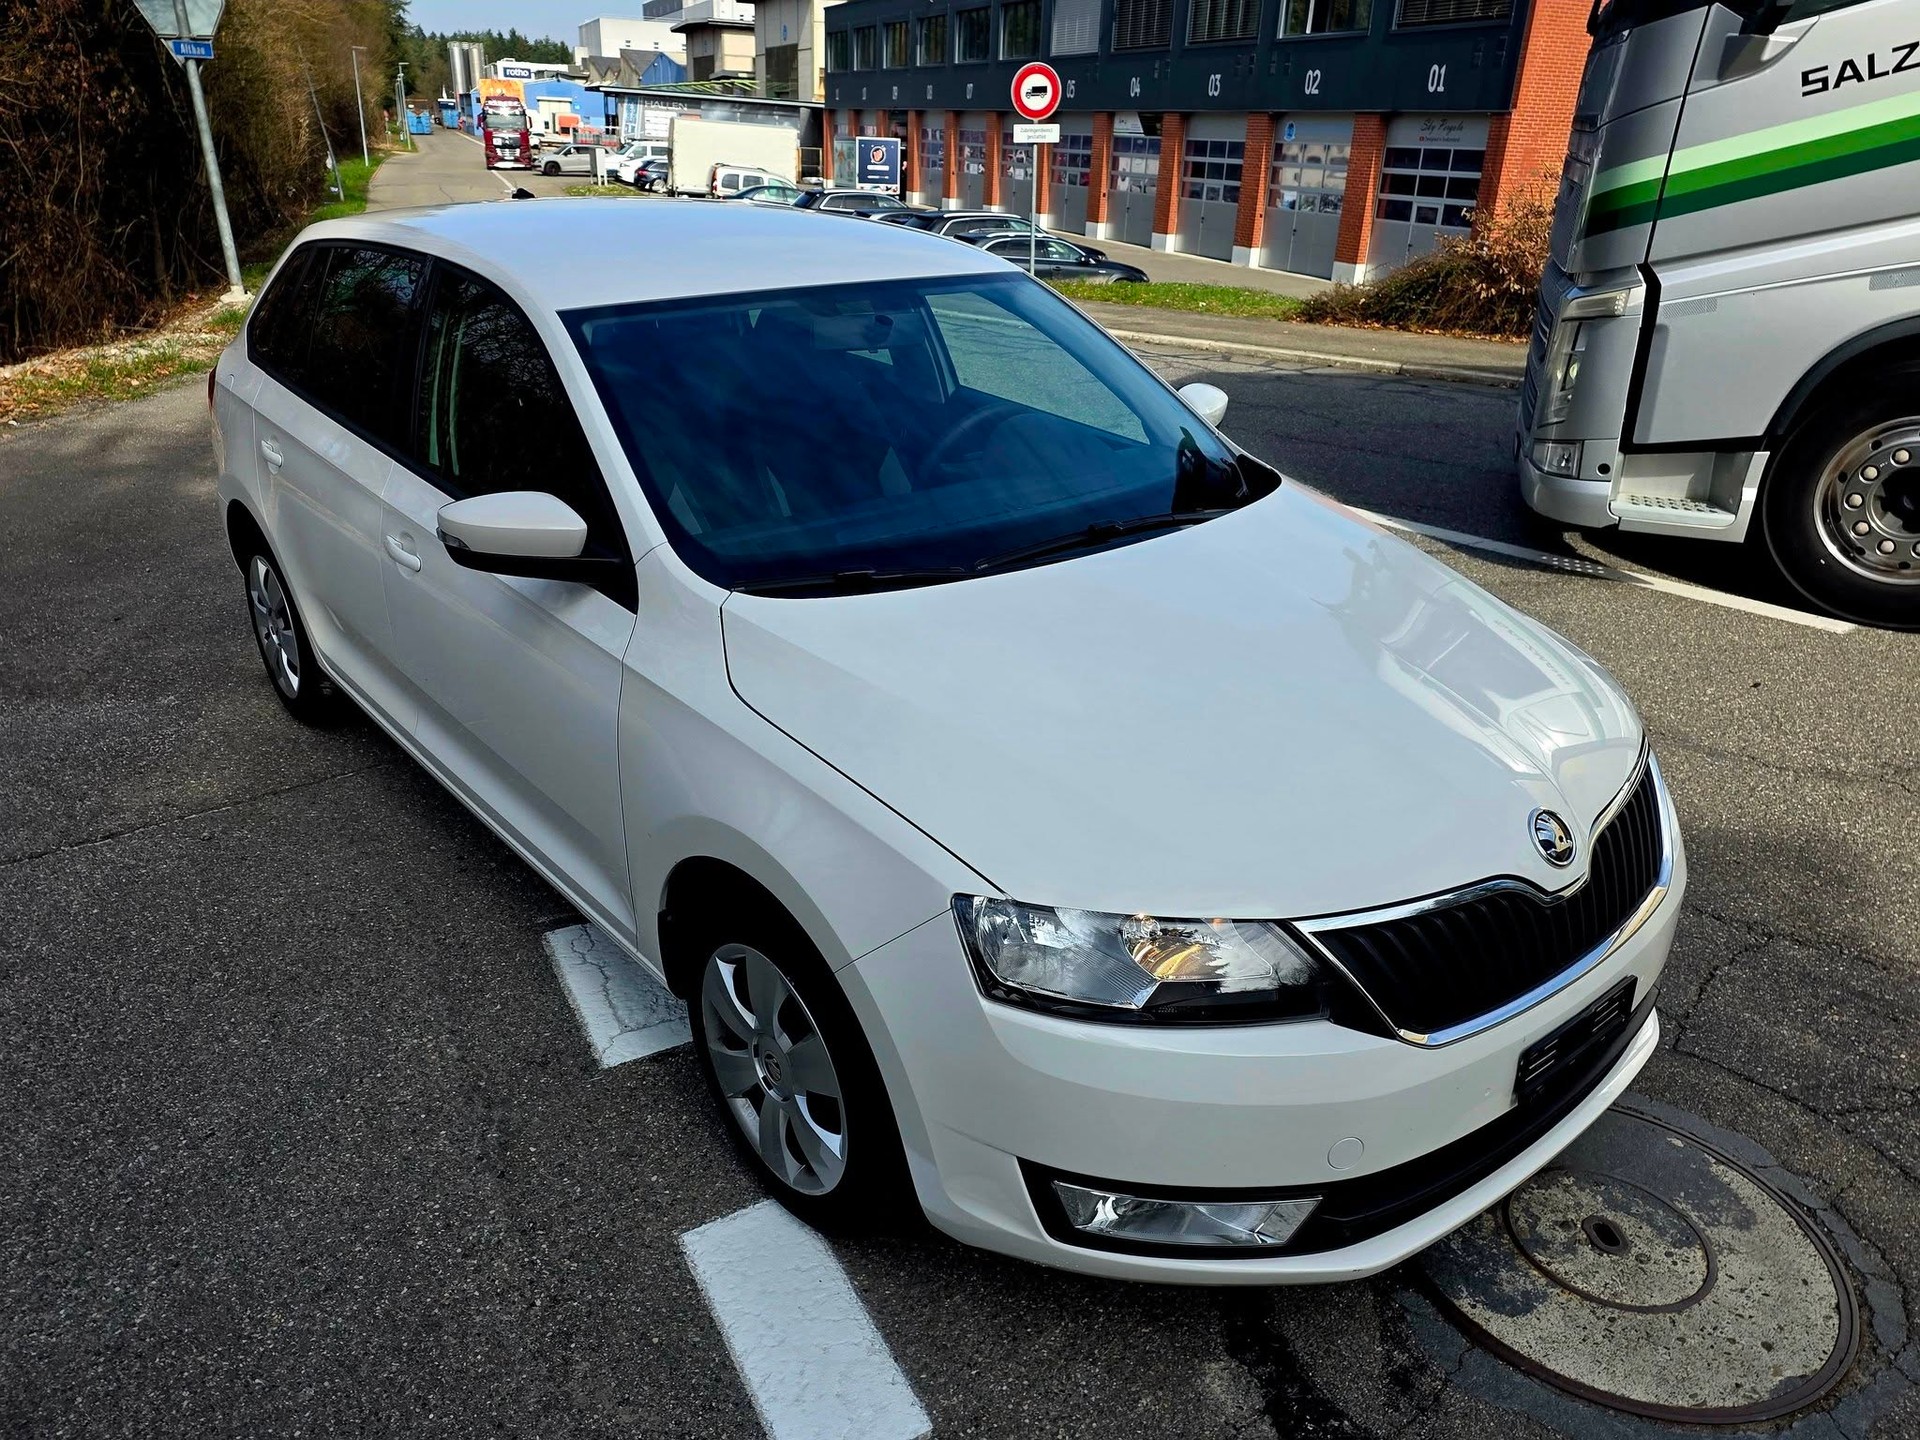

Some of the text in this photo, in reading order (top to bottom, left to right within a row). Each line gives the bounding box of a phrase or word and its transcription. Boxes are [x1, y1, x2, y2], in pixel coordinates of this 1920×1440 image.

[505, 68, 530, 77] rotho
[1304, 69, 1321, 95] 02
[1428, 64, 1447, 93] 01
[1066, 80, 1076, 98] 05
[1130, 77, 1141, 98] 04
[1208, 74, 1222, 97] 03
